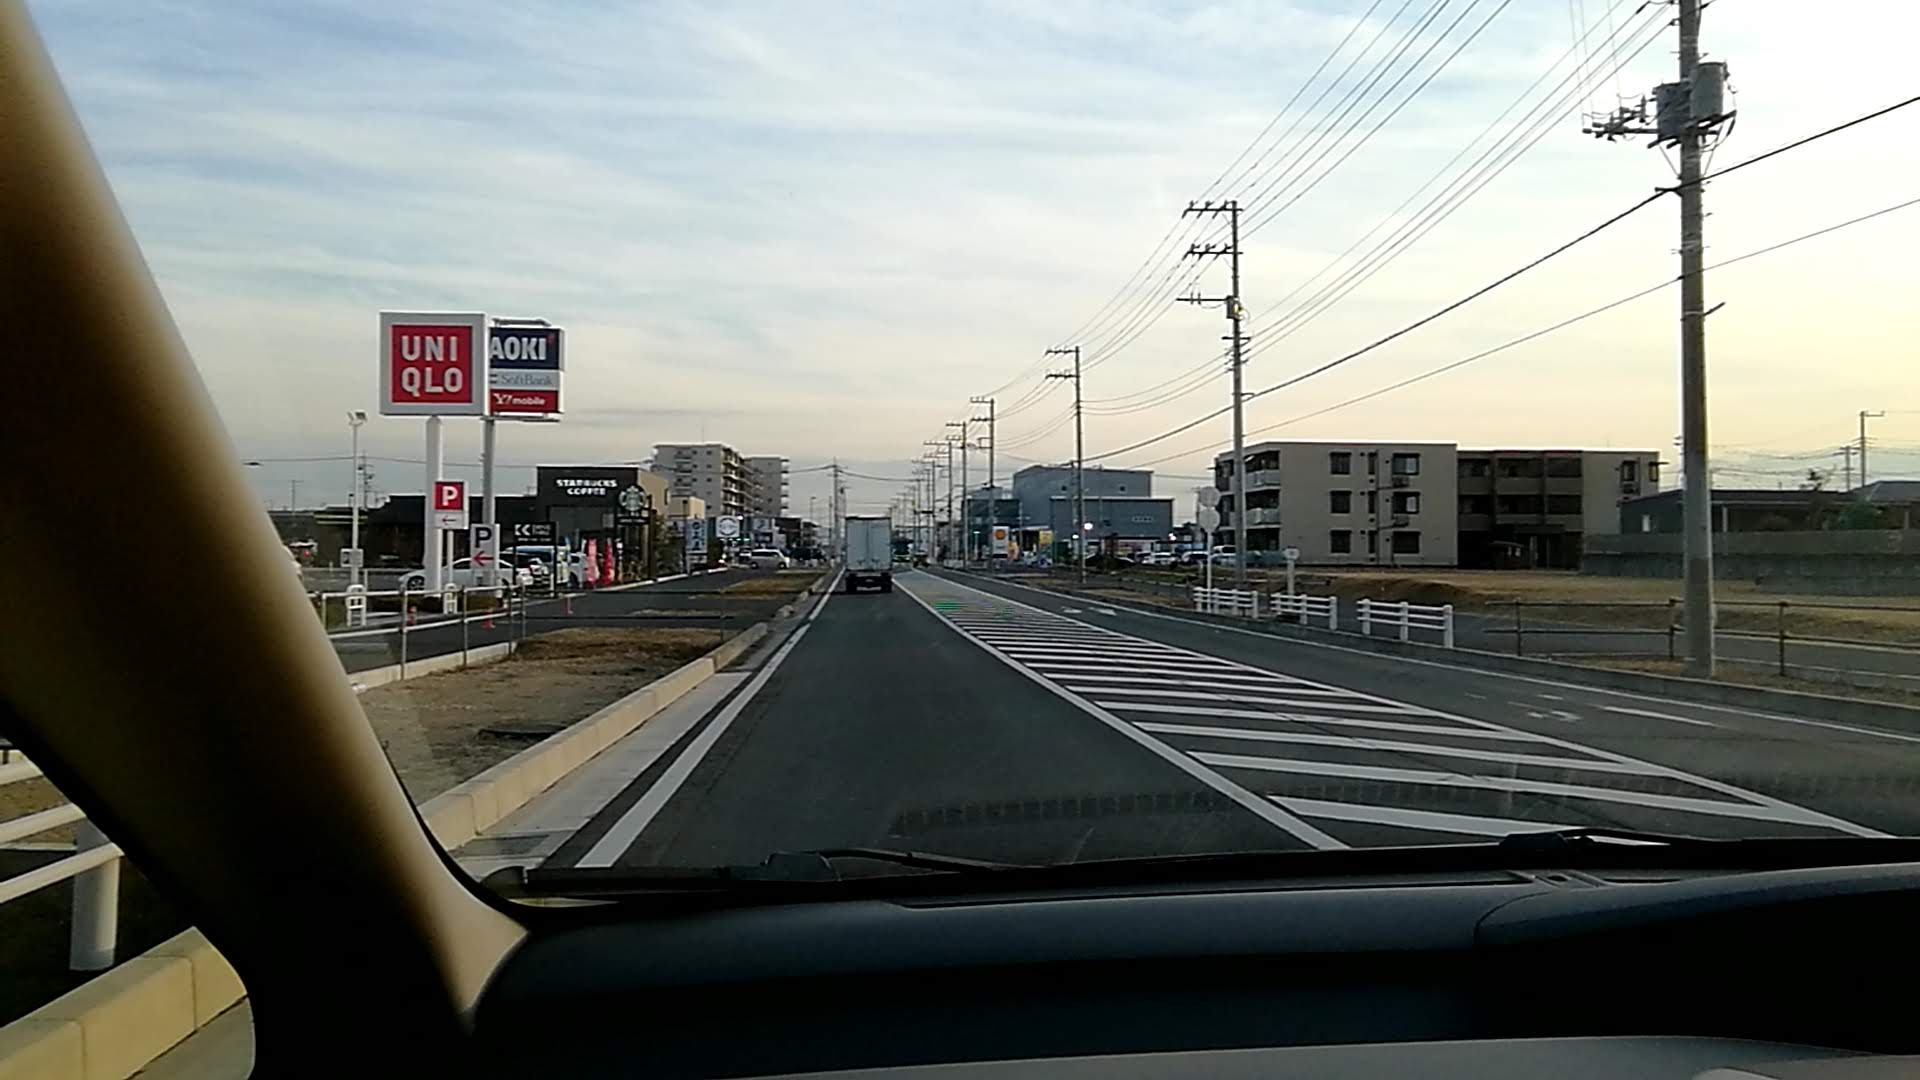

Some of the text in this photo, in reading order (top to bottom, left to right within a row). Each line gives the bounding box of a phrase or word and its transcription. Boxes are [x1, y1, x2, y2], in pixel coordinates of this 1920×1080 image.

[401, 336, 458, 361] UNI
[490, 336, 547, 360] AOKI
[401, 367, 463, 396] QLO
[556, 479, 618, 487] STARBUCKS
[567, 487, 606, 495] COFFEE
[442, 486, 458, 506] P
[475, 527, 492, 548] P
